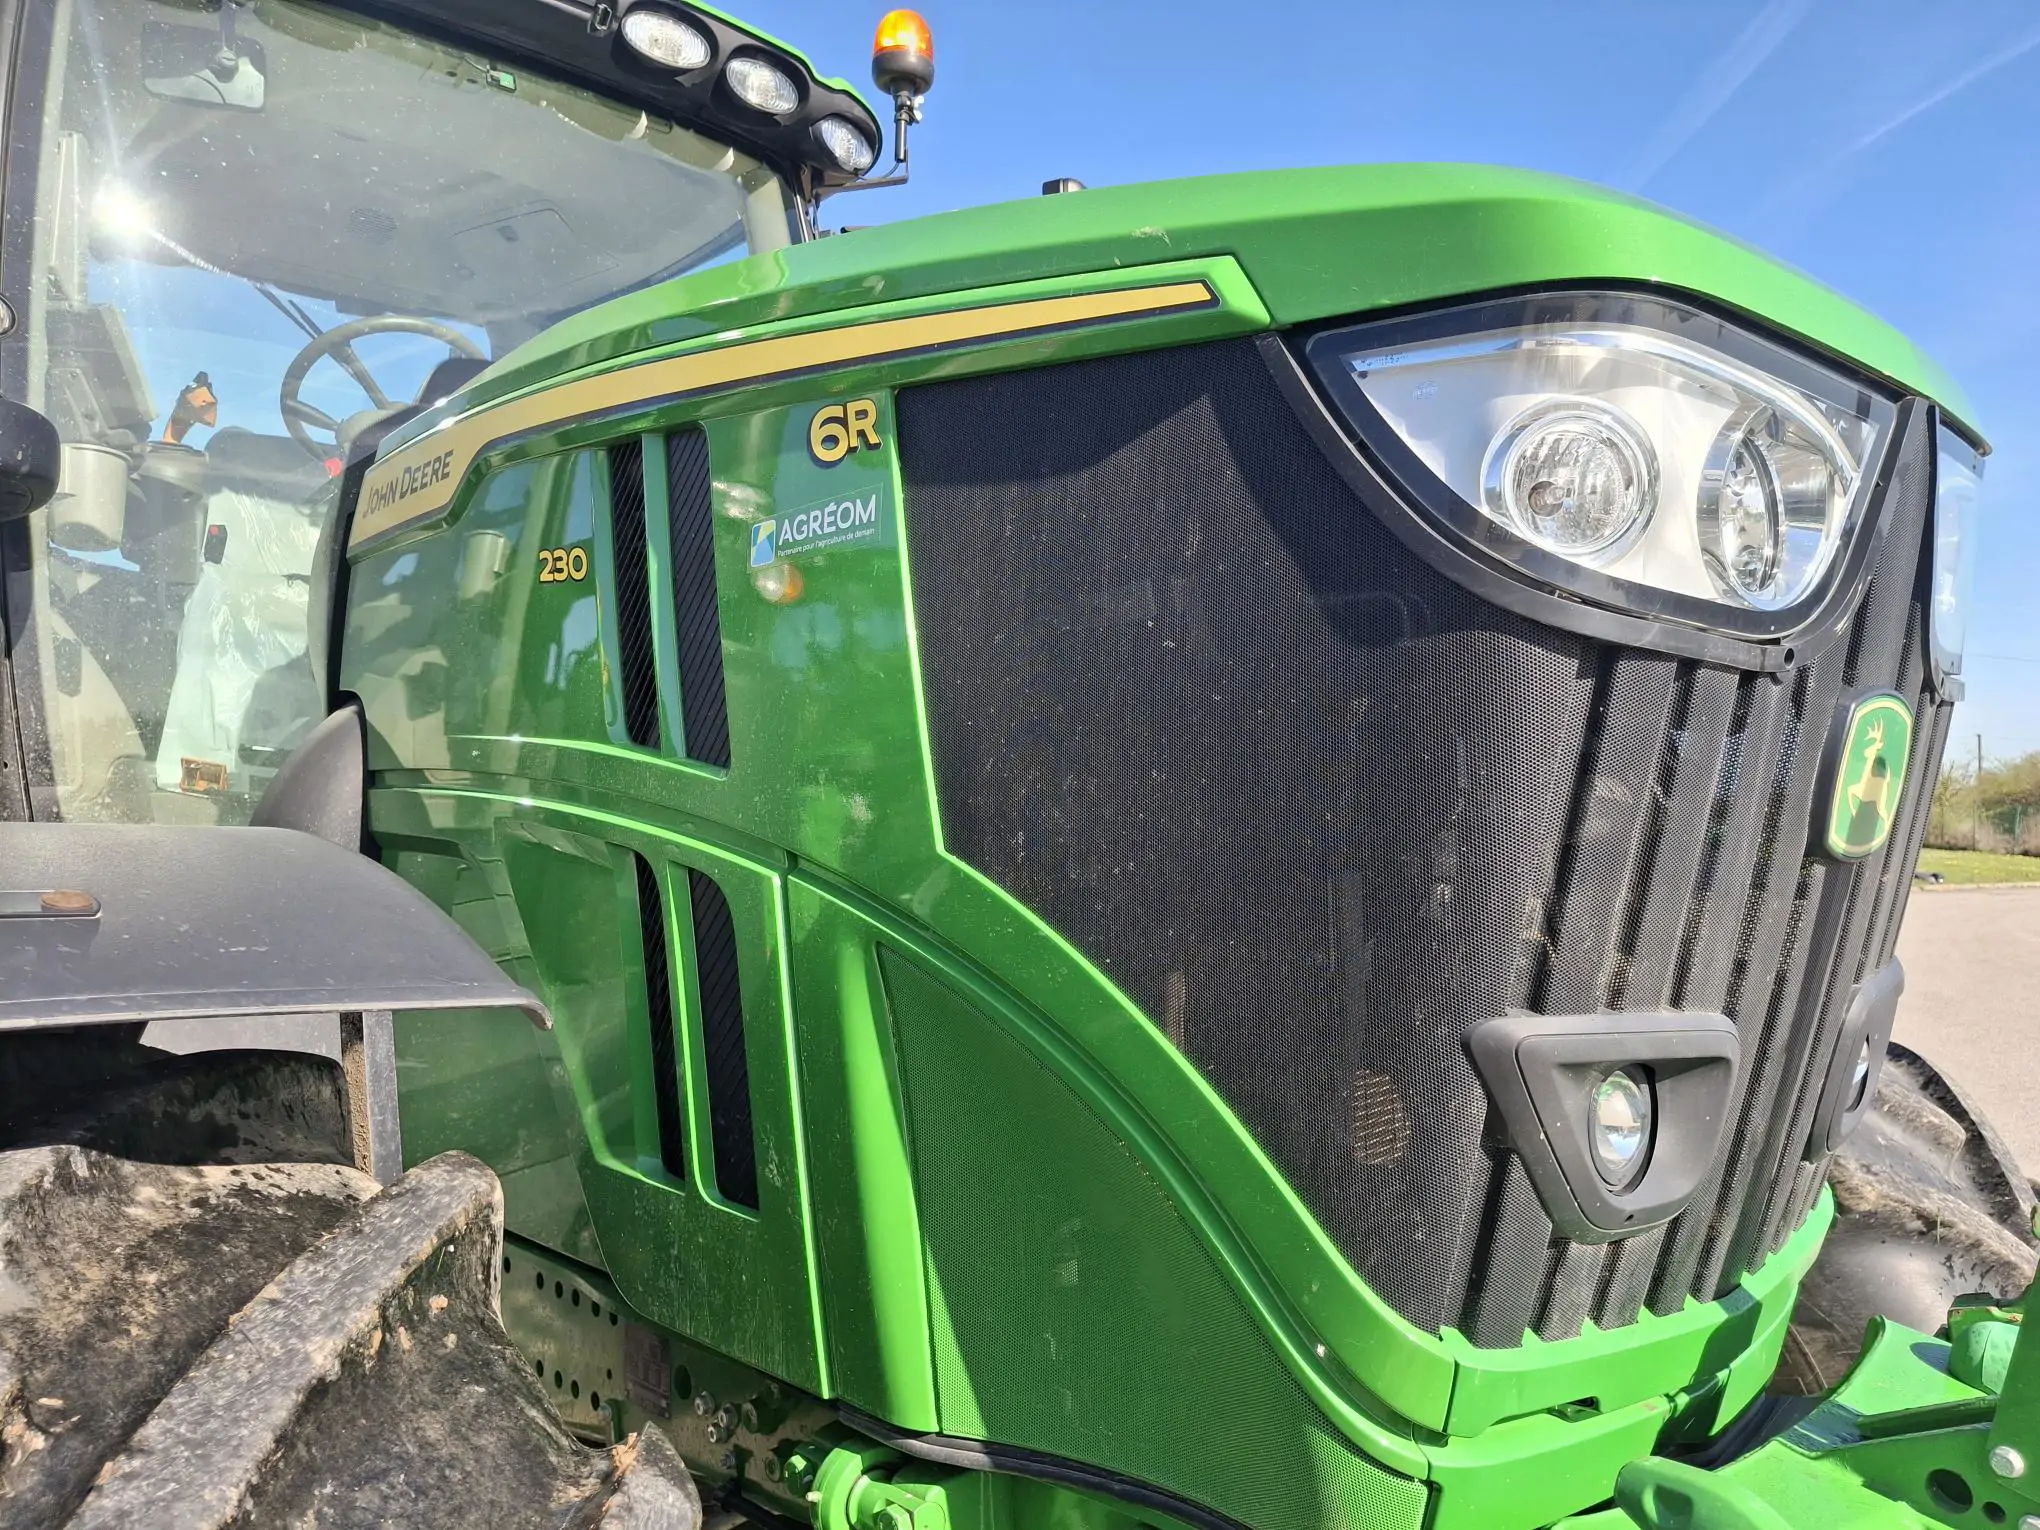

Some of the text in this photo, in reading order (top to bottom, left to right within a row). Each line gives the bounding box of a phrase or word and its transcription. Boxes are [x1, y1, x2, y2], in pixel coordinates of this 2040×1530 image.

[808, 398, 882, 466] 6R
[362, 449, 454, 519] JOHN DEERE
[777, 528, 875, 557] Partenaire pour l'agriculture de demain
[778, 494, 876, 546] AGRÉOM
[538, 546, 589, 583] 230
